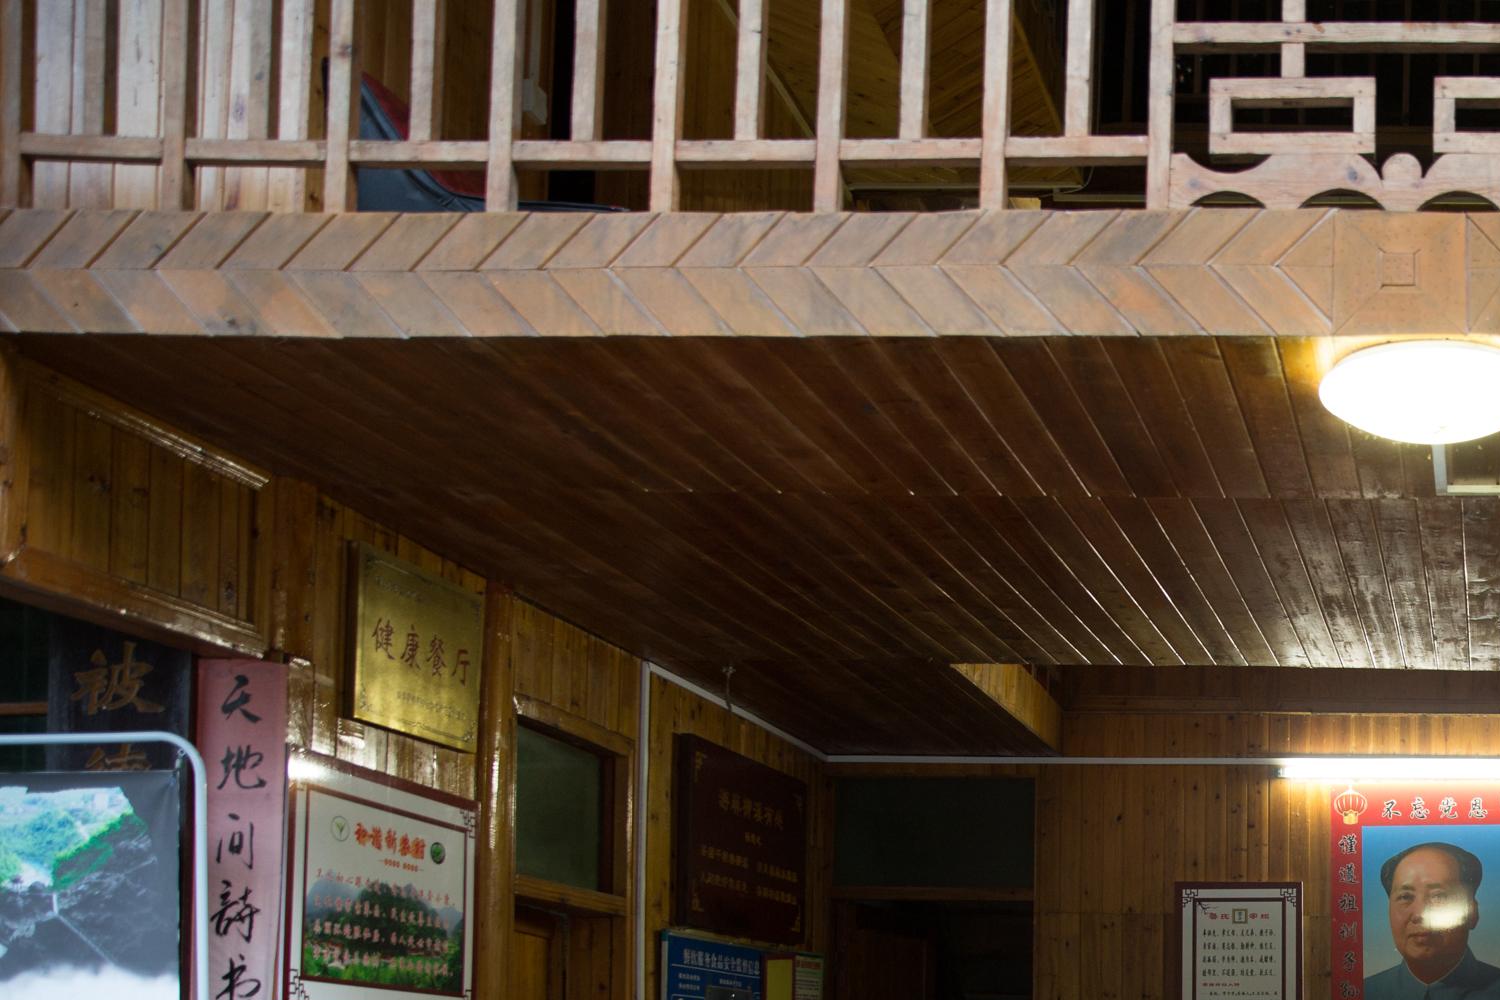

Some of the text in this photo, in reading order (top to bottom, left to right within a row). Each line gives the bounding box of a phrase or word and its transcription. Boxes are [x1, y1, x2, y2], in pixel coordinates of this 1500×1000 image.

[371, 617, 471, 687] 健康餐厅
[1381, 797, 1488, 819] 不忘党恩
